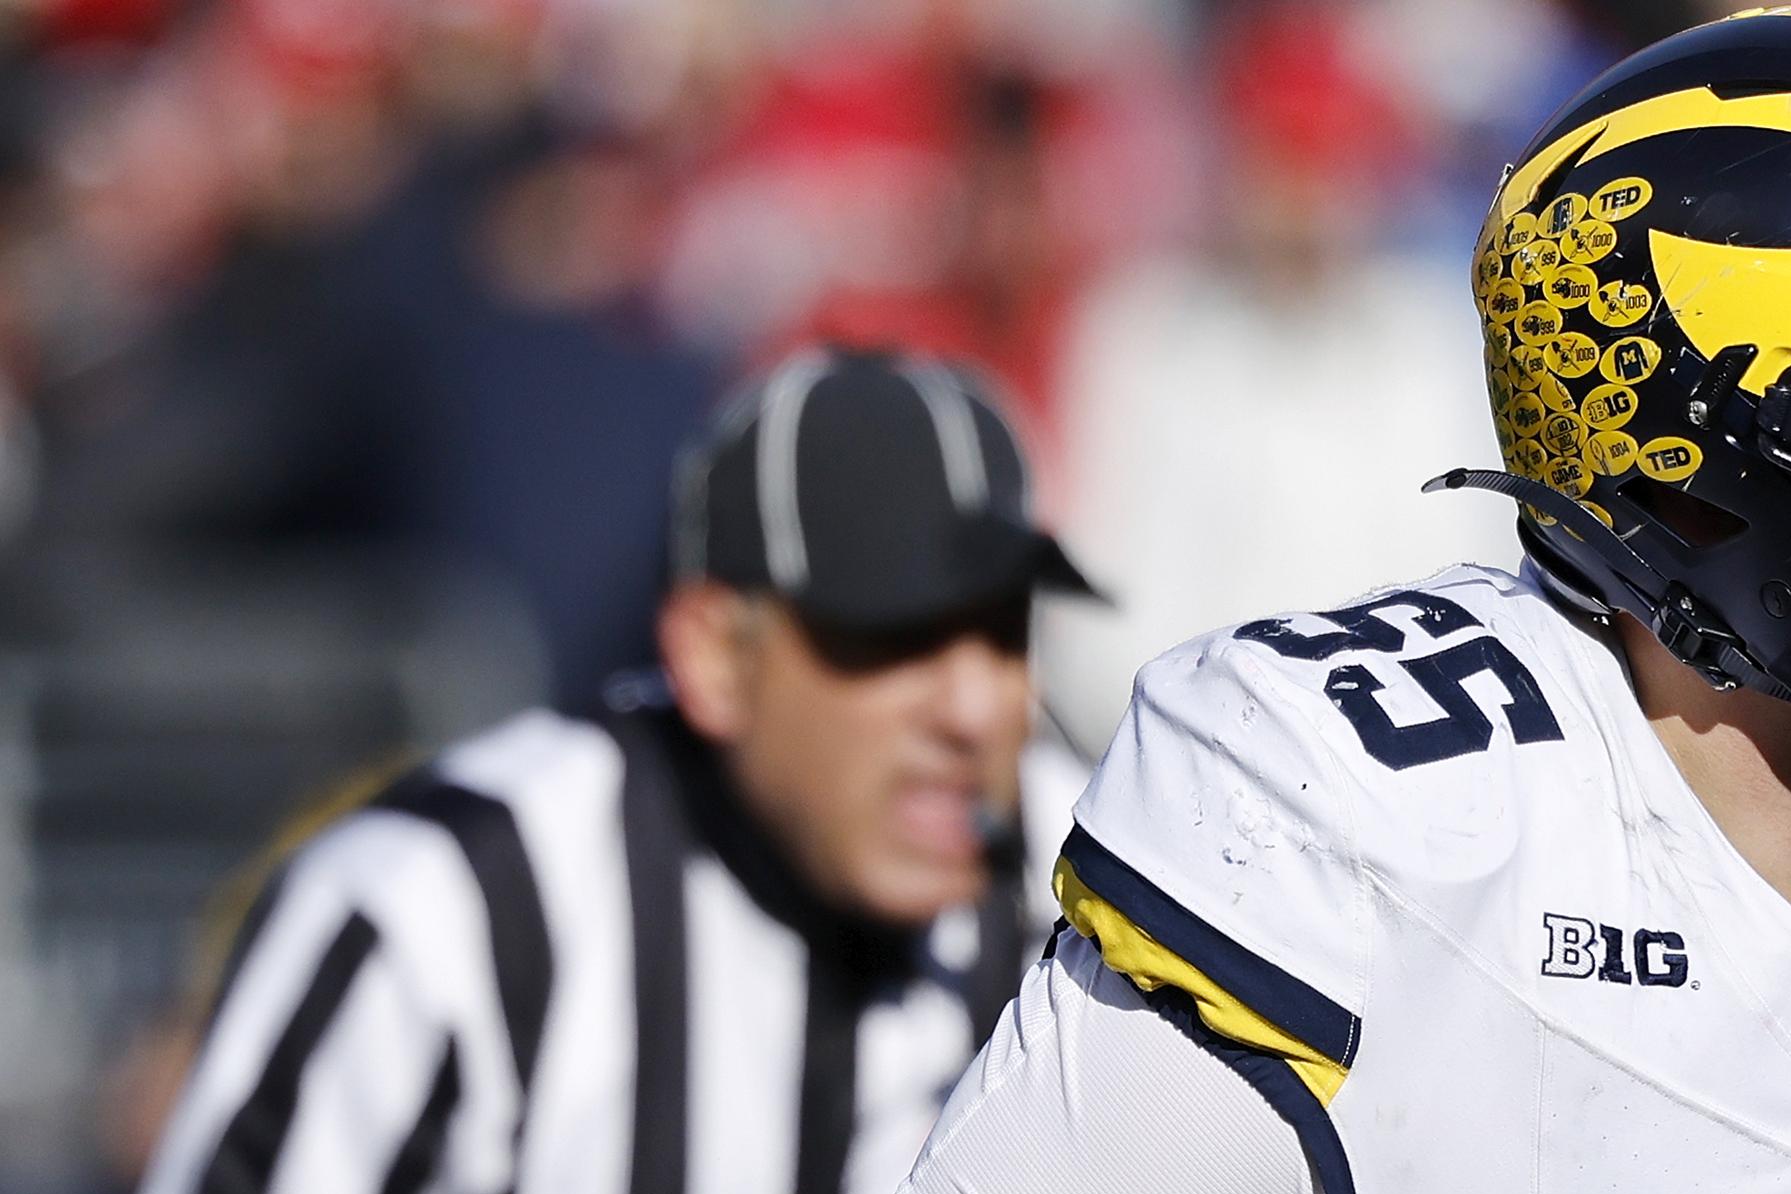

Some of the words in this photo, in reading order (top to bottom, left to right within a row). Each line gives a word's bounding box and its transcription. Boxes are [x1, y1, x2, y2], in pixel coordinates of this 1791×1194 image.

[1600, 185, 1642, 213] TED
[1591, 233, 1613, 248] 1000
[1625, 294, 1647, 309] 1003
[1621, 348, 1638, 366] M
[1645, 446, 1691, 472] TED
[1551, 464, 1583, 486] GAME
[1233, 590, 1565, 772] 55
